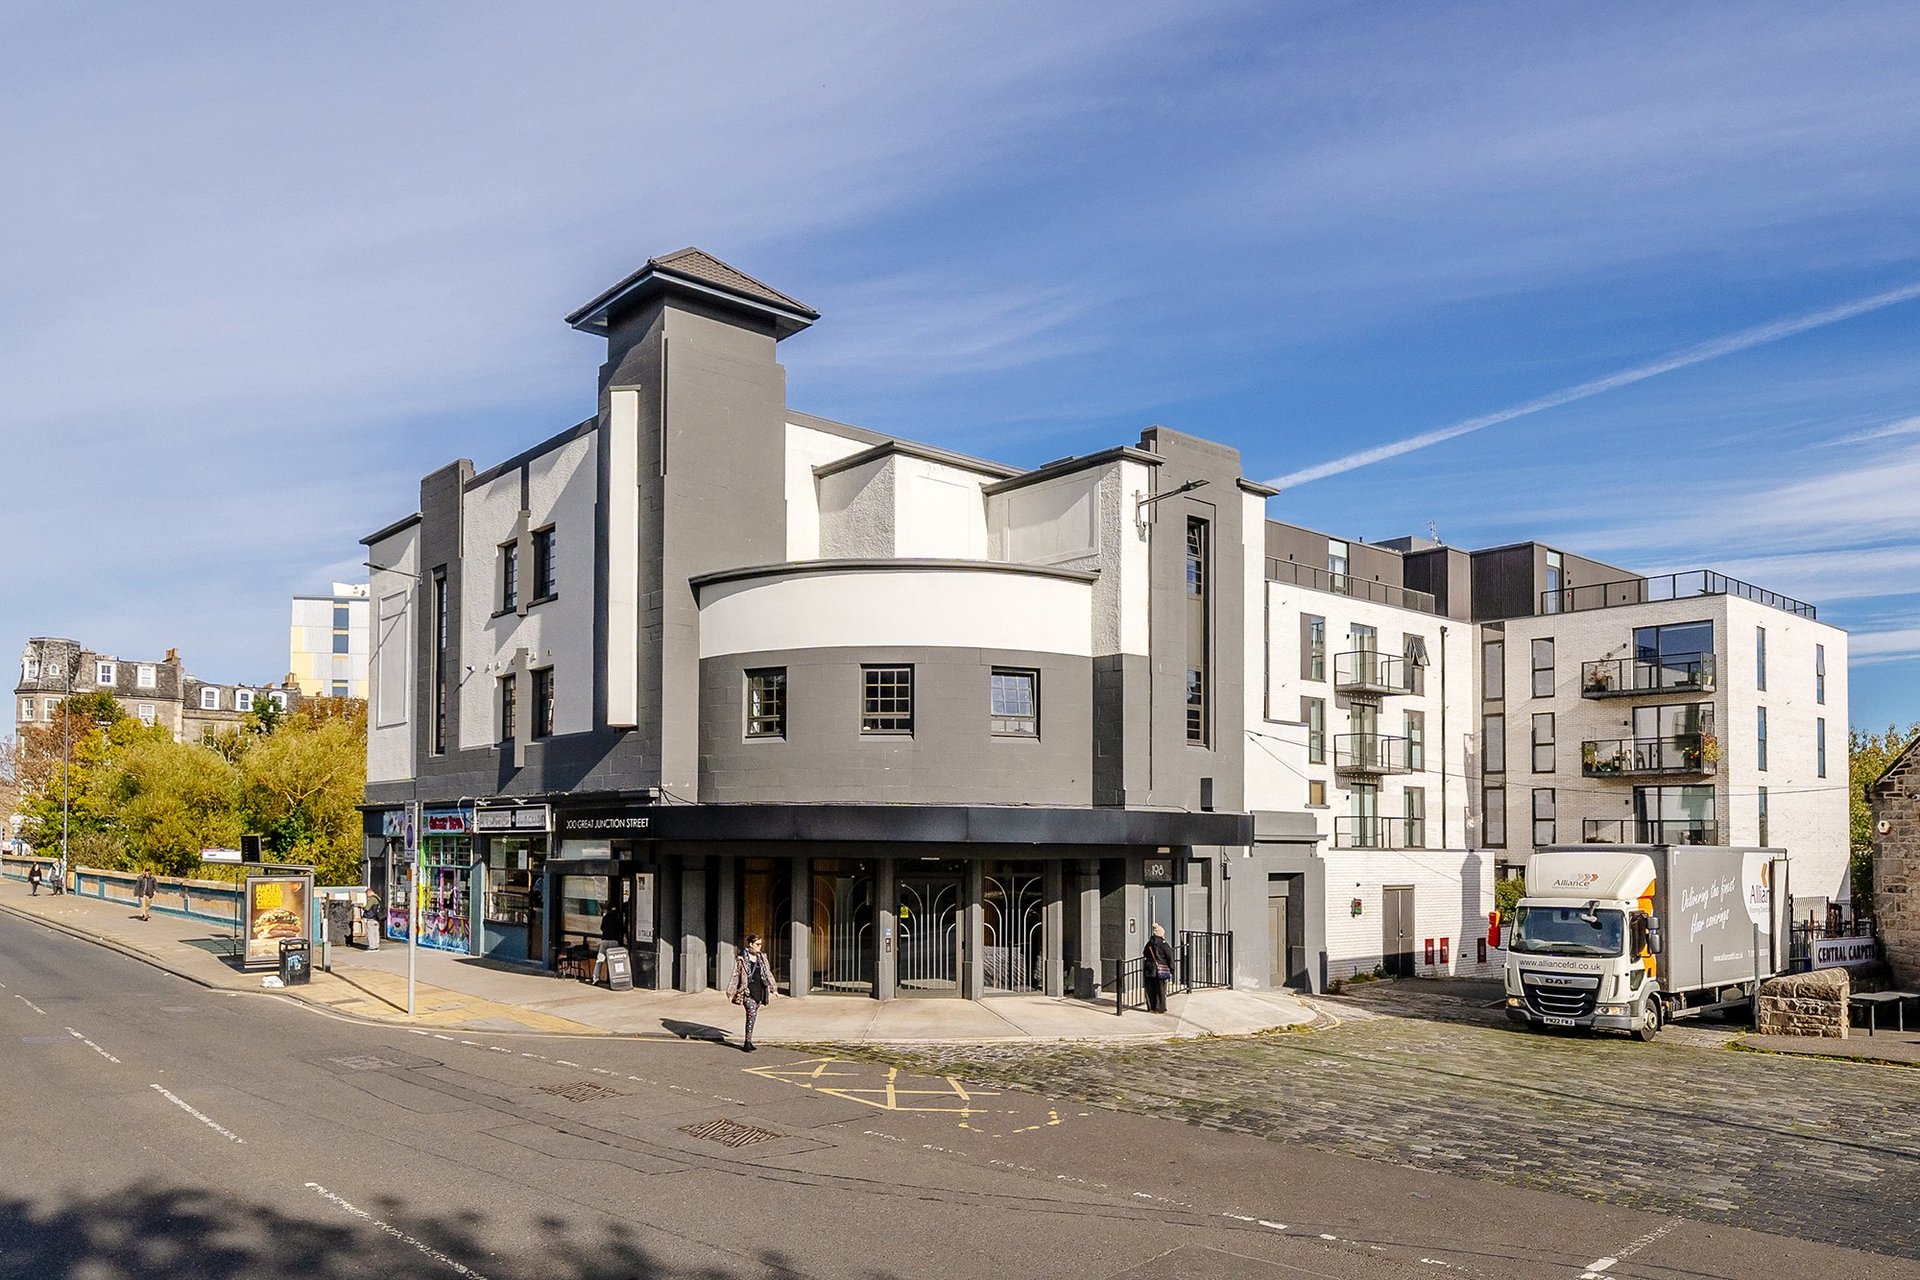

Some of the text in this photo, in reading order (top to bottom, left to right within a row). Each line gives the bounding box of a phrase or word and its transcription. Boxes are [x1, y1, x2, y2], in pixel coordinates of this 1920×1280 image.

[577, 819, 595, 829] GREAT
[594, 818, 626, 829] JUNCTION
[626, 817, 649, 828] STREET
[1151, 864, 1165, 876] 198
[1553, 879, 1591, 887] Alliance
[1681, 886, 1709, 913] Delivering
[1710, 879, 1720, 899] the
[1749, 884, 1770, 904] Allian
[1818, 943, 1876, 963] CENTRAL CARPETS
[1520, 959, 1601, 971] www.alliancefdl.co.uk
